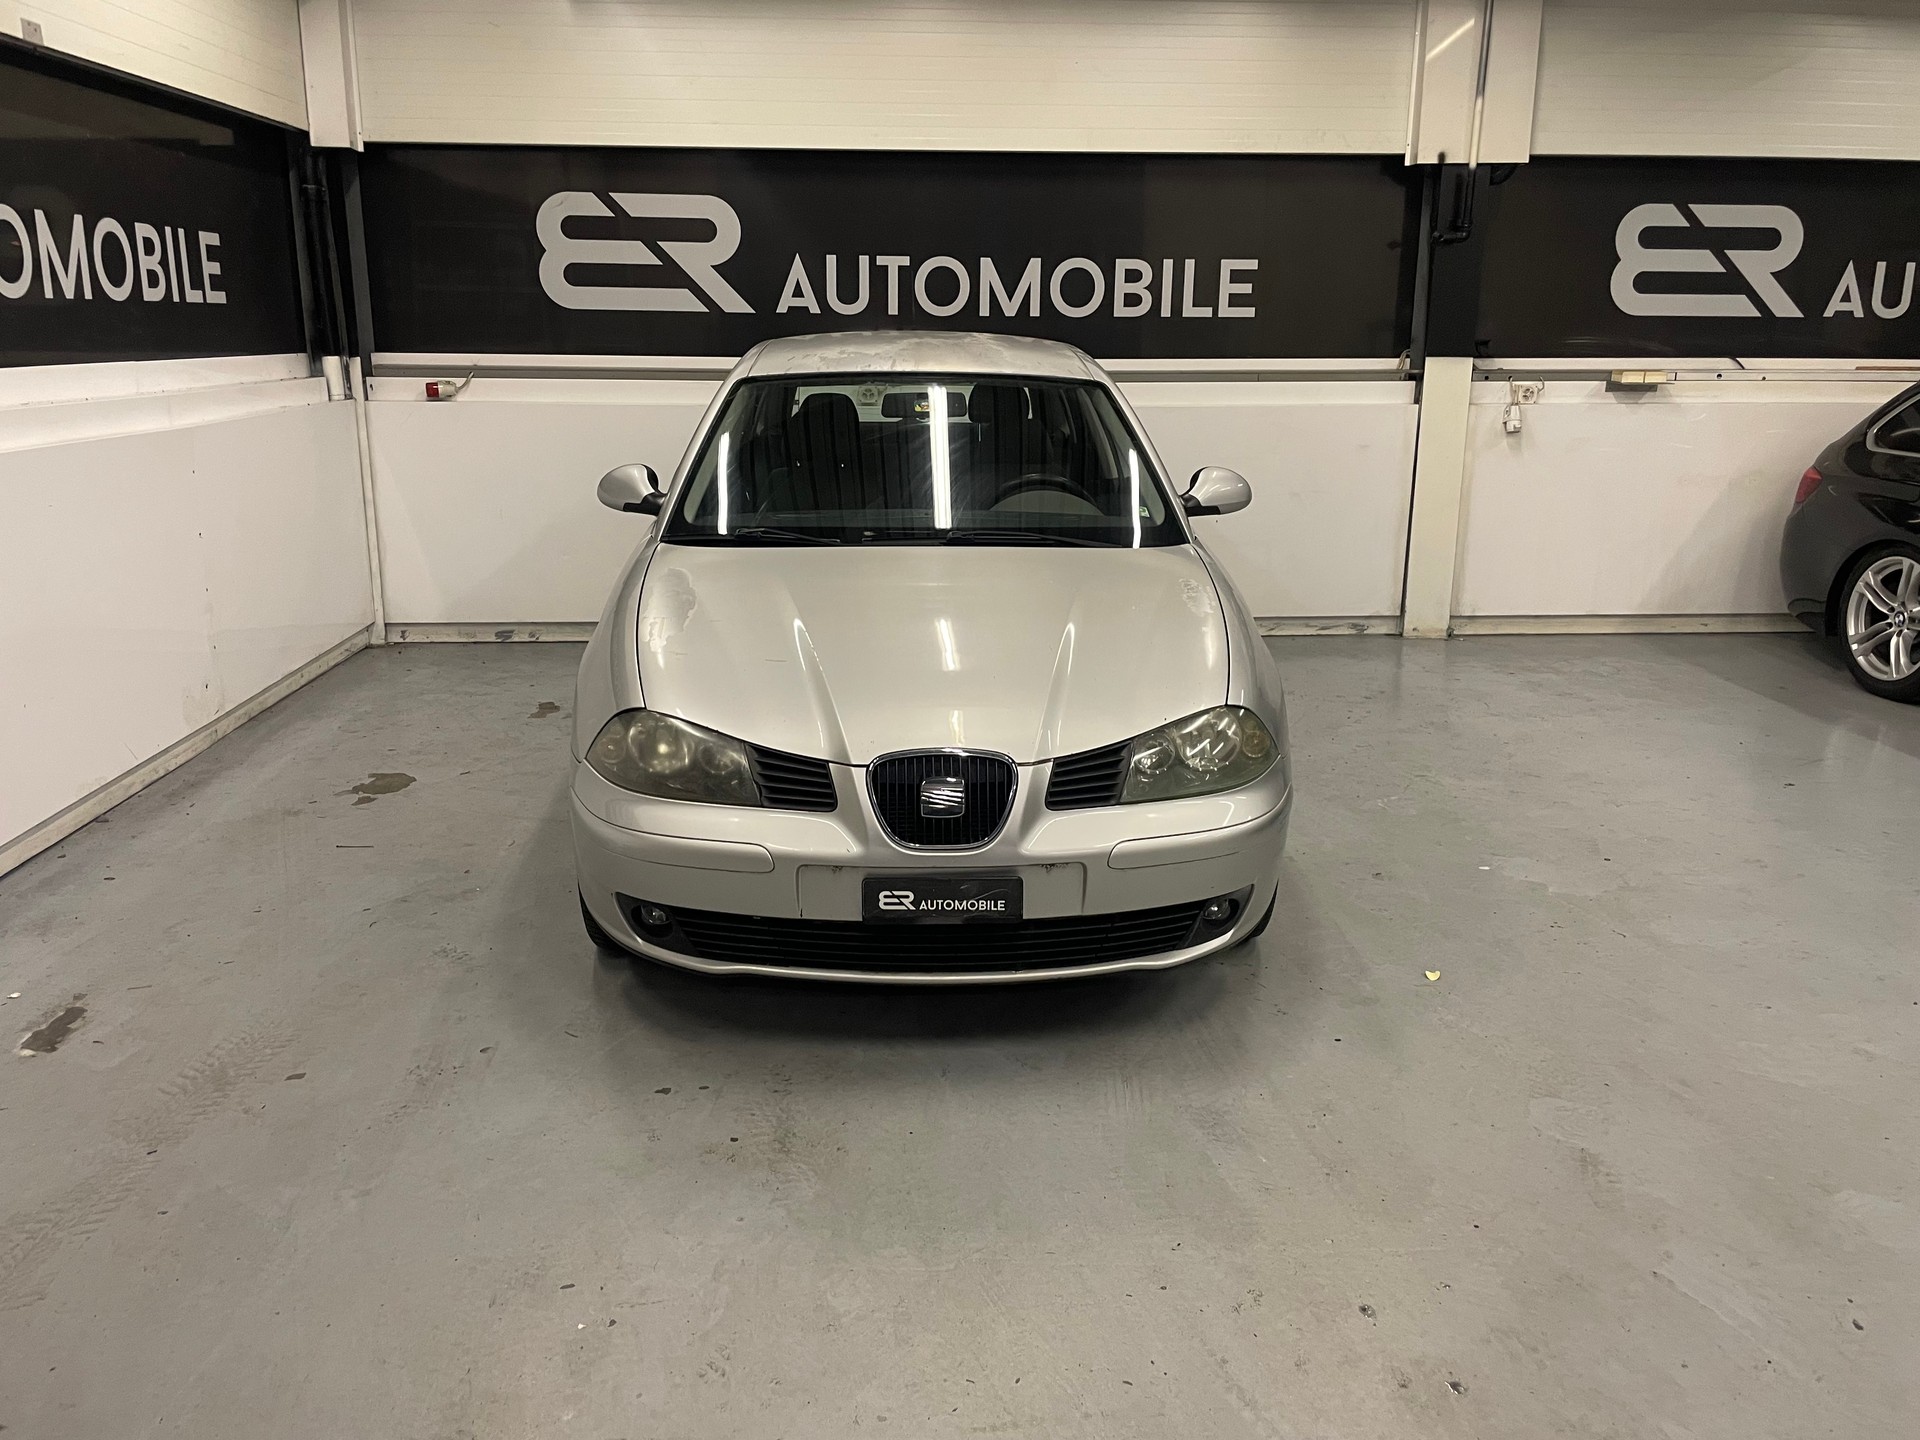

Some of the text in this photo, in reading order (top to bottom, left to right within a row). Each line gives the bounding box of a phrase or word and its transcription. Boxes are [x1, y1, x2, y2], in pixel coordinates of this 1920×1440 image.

[776, 253, 1259, 318] AUTOMOBILE
[1822, 259, 1917, 319] AU
[919, 899, 1006, 911] AUTOMOBILE
